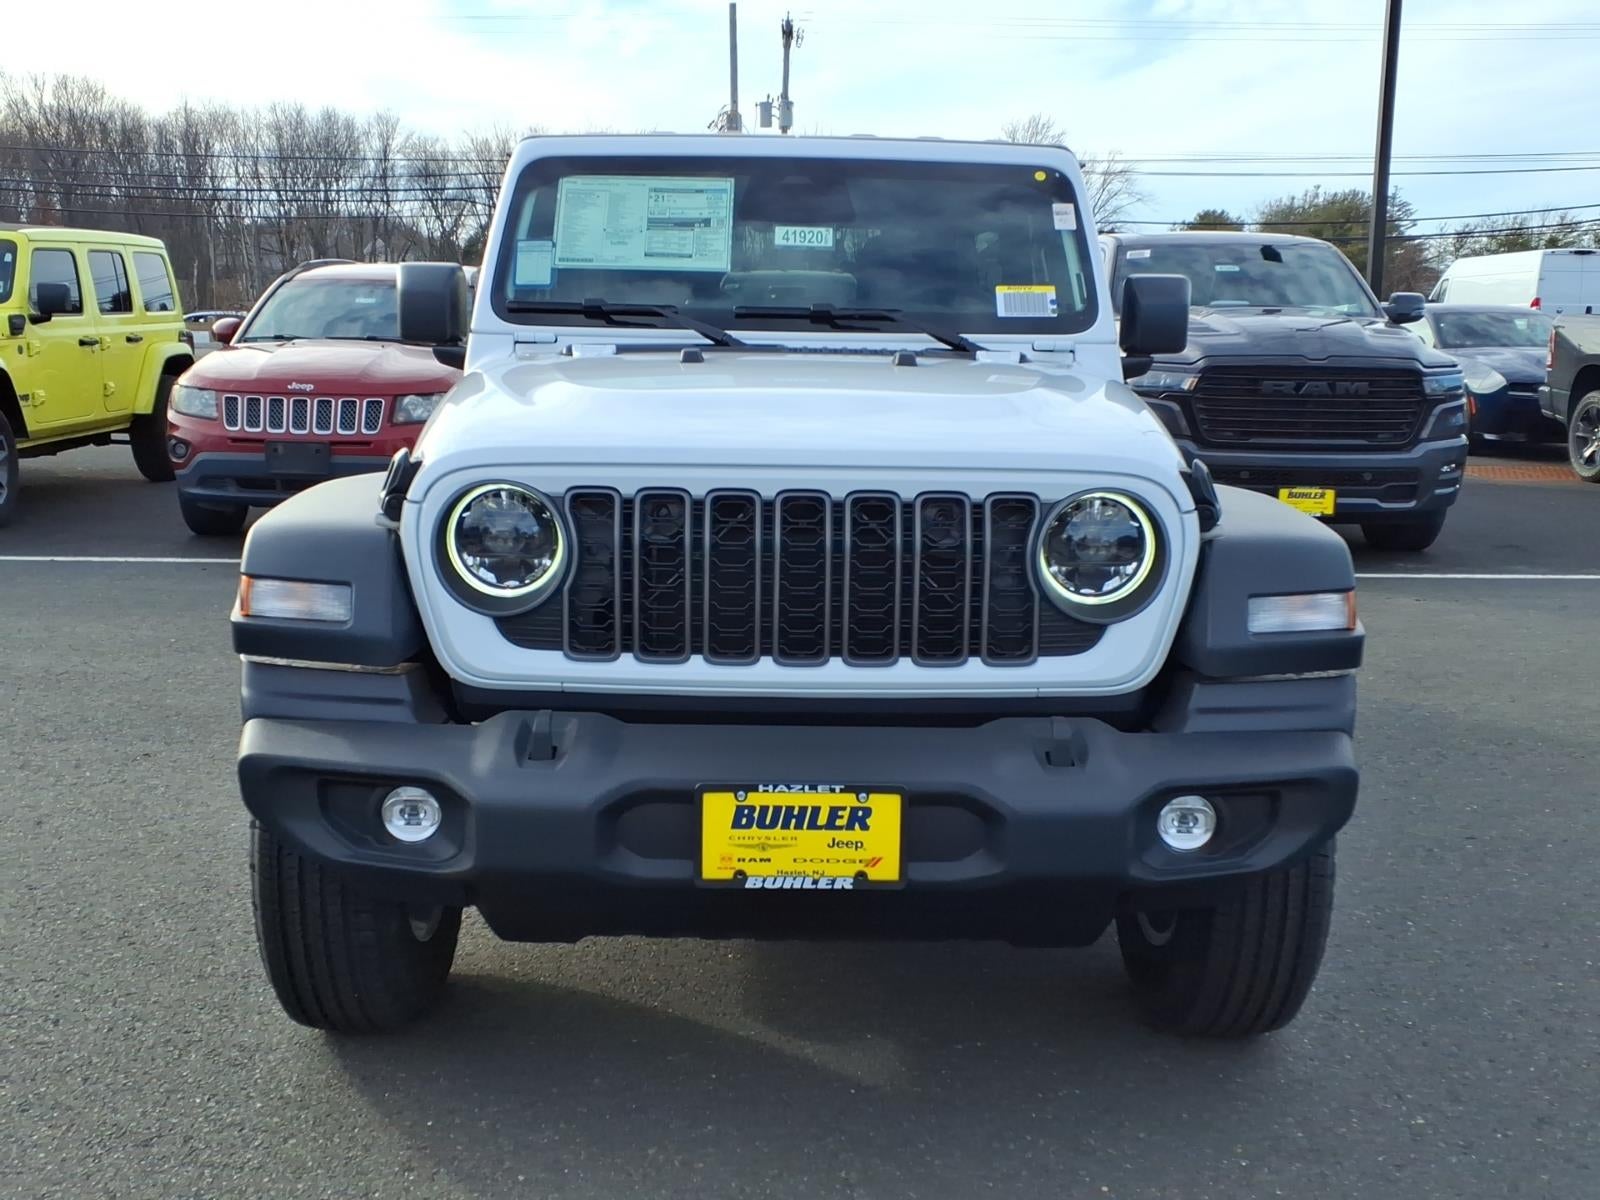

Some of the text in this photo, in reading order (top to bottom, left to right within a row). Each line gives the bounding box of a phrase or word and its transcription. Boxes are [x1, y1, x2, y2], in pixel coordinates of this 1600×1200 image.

[782, 229, 823, 244] 41920
[287, 382, 314, 391] Jeep
[1262, 380, 1369, 395] RAM
[1287, 491, 1326, 499] BUHLER
[758, 784, 845, 793] HAZLET
[730, 804, 873, 831] BUHLER
[827, 837, 864, 851] Jeep
[744, 876, 854, 889] BUHLER
